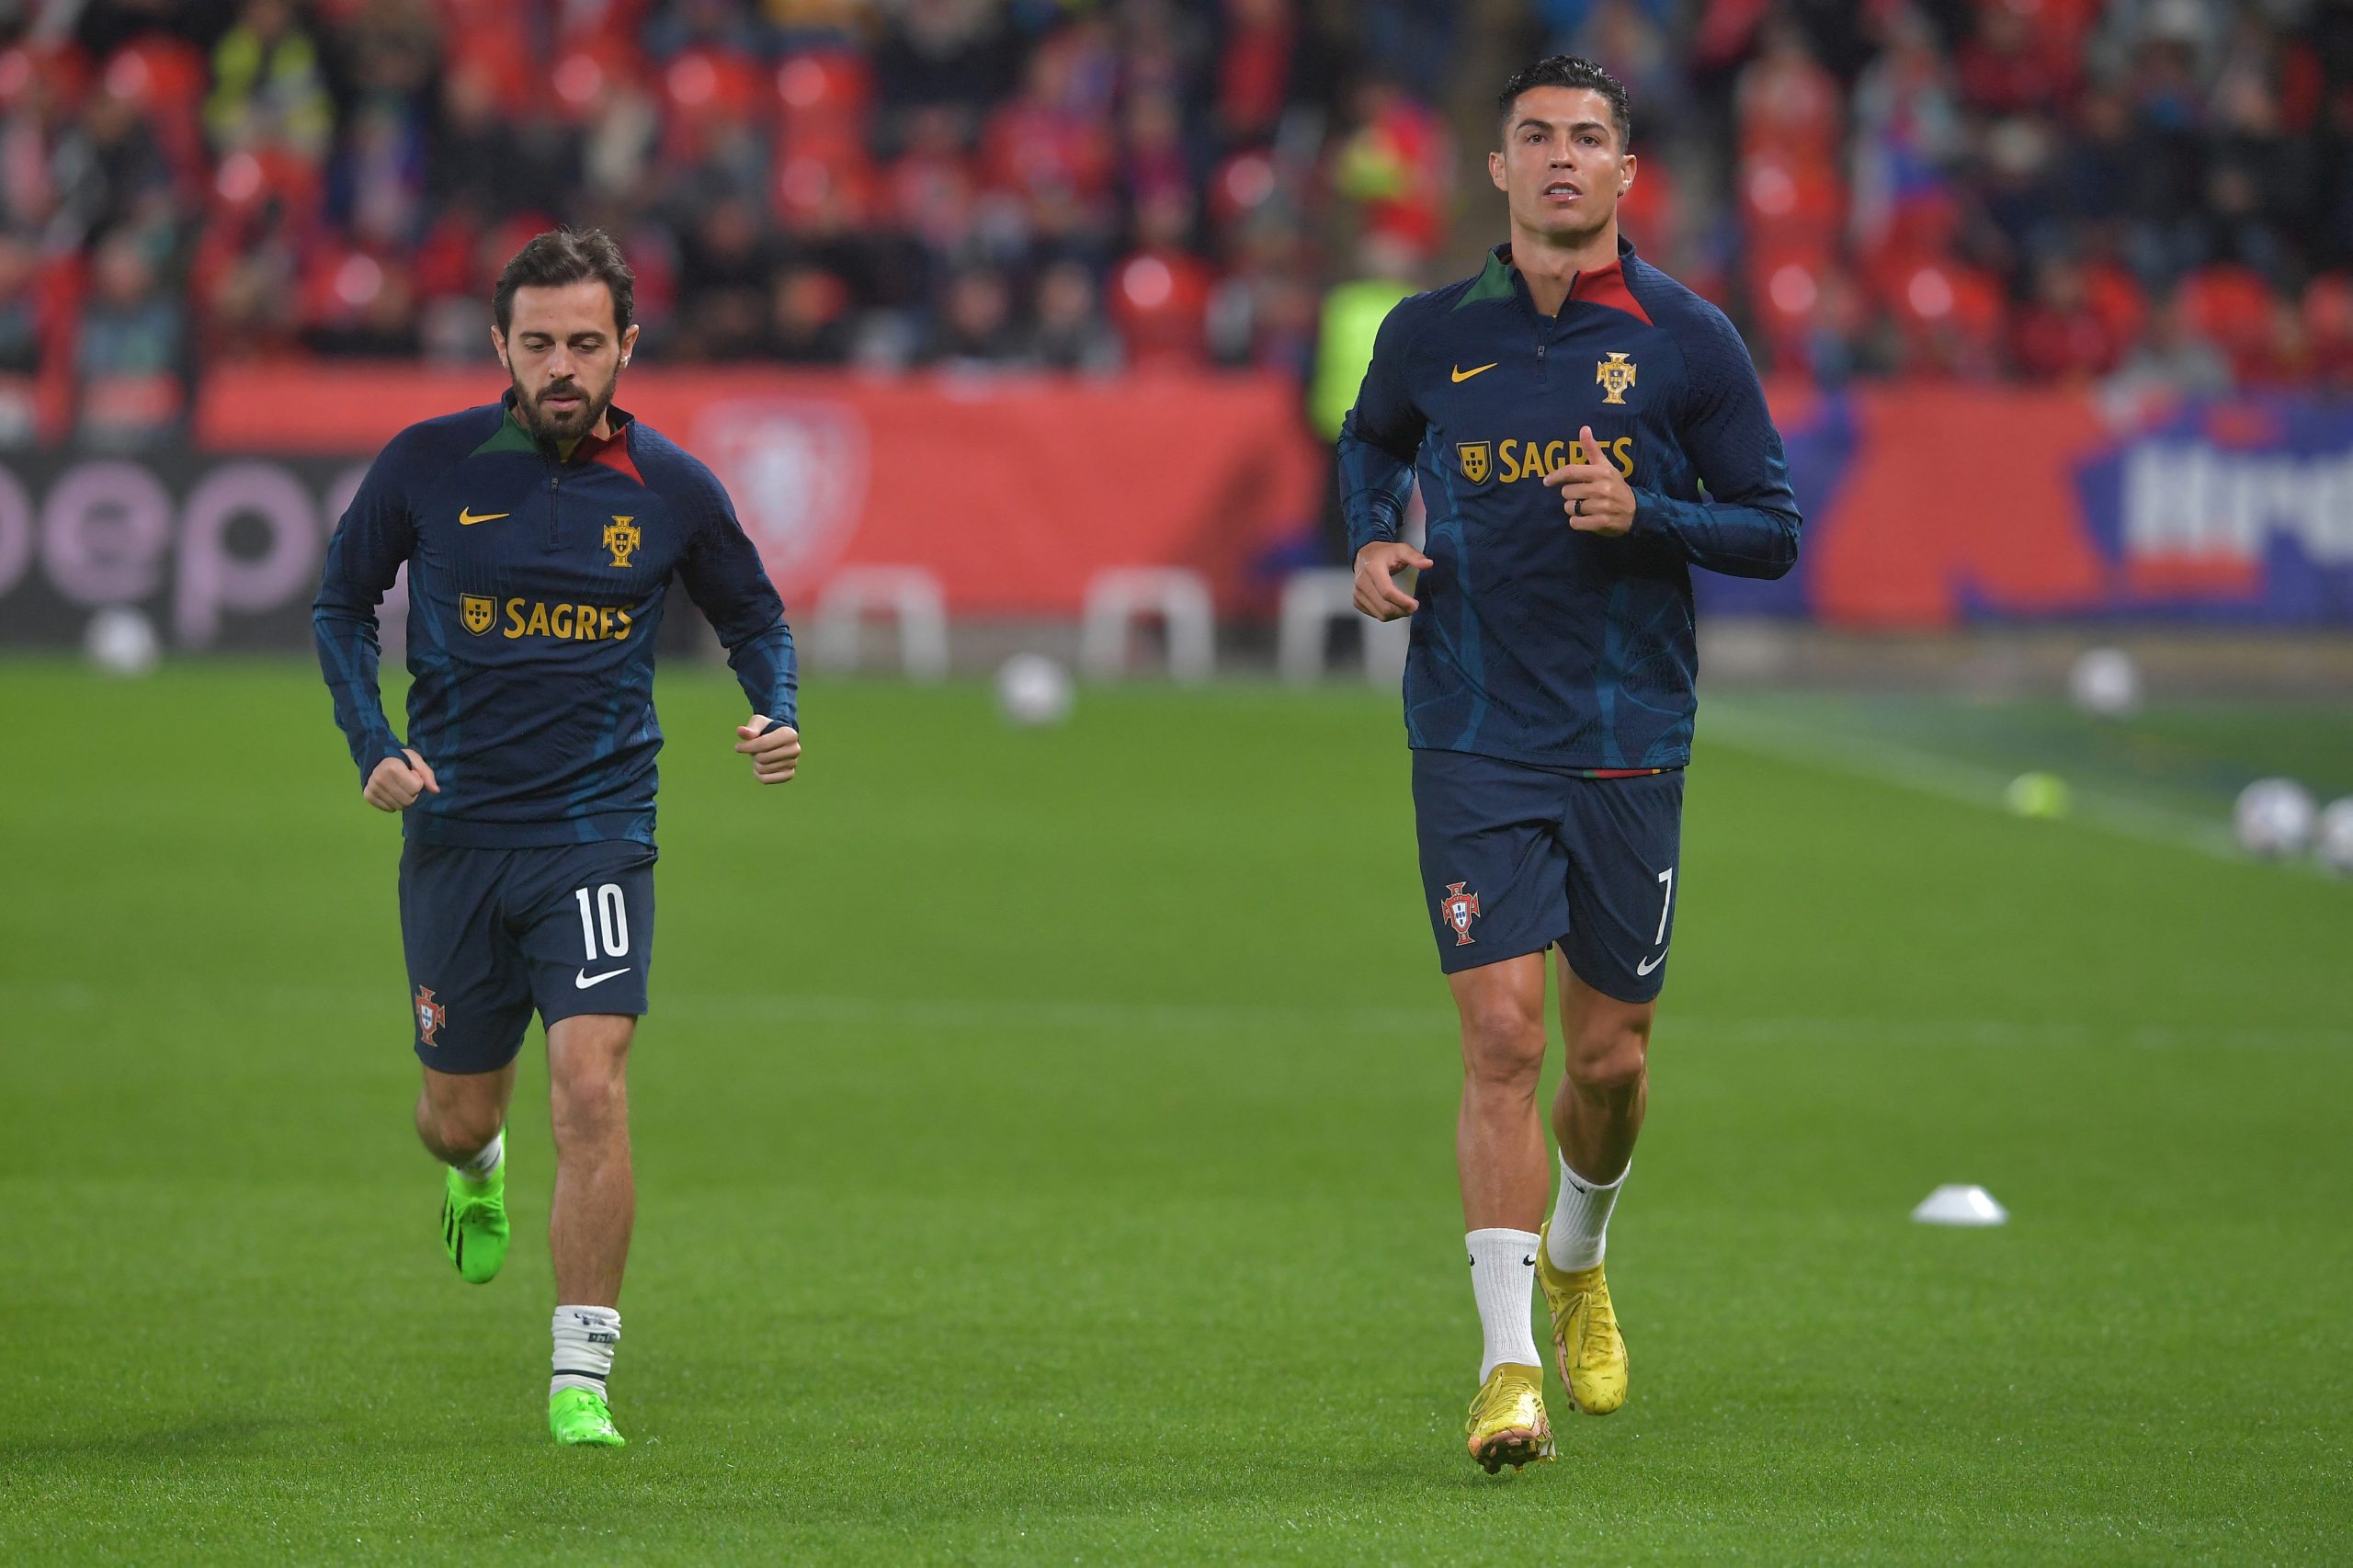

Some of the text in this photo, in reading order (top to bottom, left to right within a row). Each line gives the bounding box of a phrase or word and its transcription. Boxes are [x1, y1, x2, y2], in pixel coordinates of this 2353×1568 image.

[1498, 437, 1634, 483] SAGRS
[503, 597, 634, 641] SAGRES
[575, 883, 630, 960] 10
[1654, 868, 1673, 946] 7
